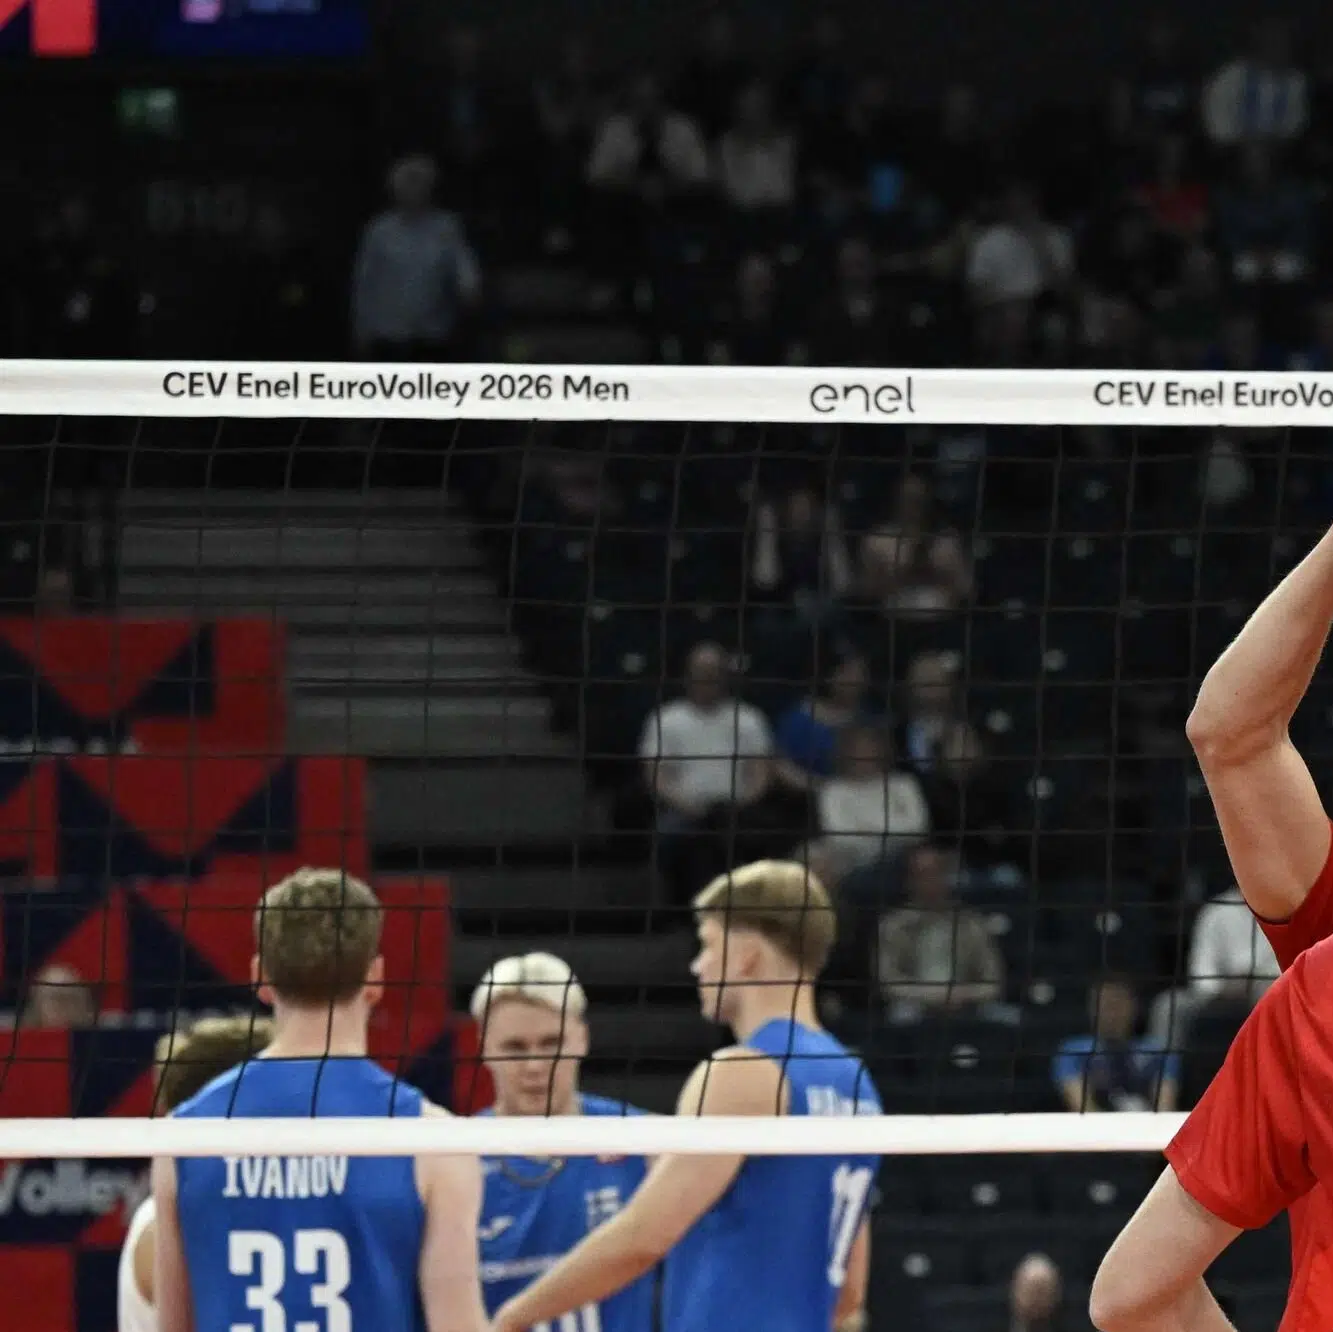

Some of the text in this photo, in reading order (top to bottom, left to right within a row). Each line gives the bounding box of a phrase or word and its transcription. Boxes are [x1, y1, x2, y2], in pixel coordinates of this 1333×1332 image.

[162, 371, 629, 407] CEV Enel EuroVolley 2026 Men
[808, 376, 915, 414] enel
[1093, 381, 1155, 406] CEV
[1164, 380, 1223, 406] Enel
[222, 1155, 349, 1199] IVANOV
